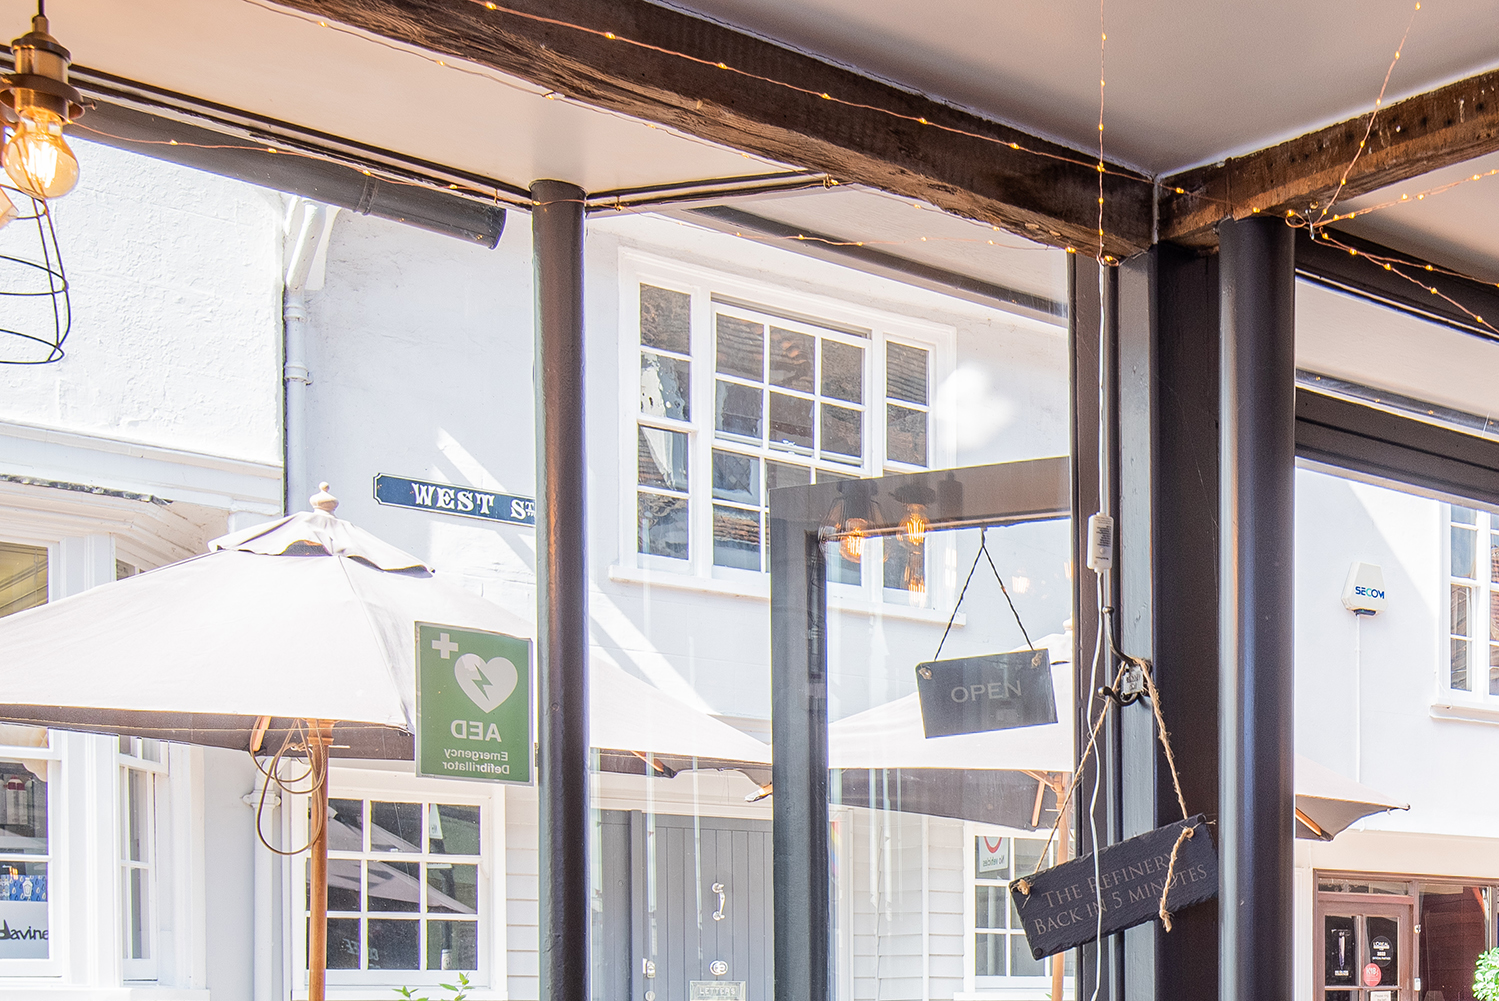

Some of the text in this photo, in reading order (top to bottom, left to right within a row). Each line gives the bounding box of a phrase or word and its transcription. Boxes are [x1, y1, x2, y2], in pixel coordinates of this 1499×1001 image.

[411, 482, 495, 515] WEST
[1355, 586, 1385, 599] SECOM
[951, 680, 1022, 702] OPEN
[1042, 884, 1083, 908] THE
[1034, 905, 1083, 935] BACK
[1087, 898, 1108, 917] IN
[1112, 892, 1123, 909] 5
[699, 987, 736, 996] LETTERS
